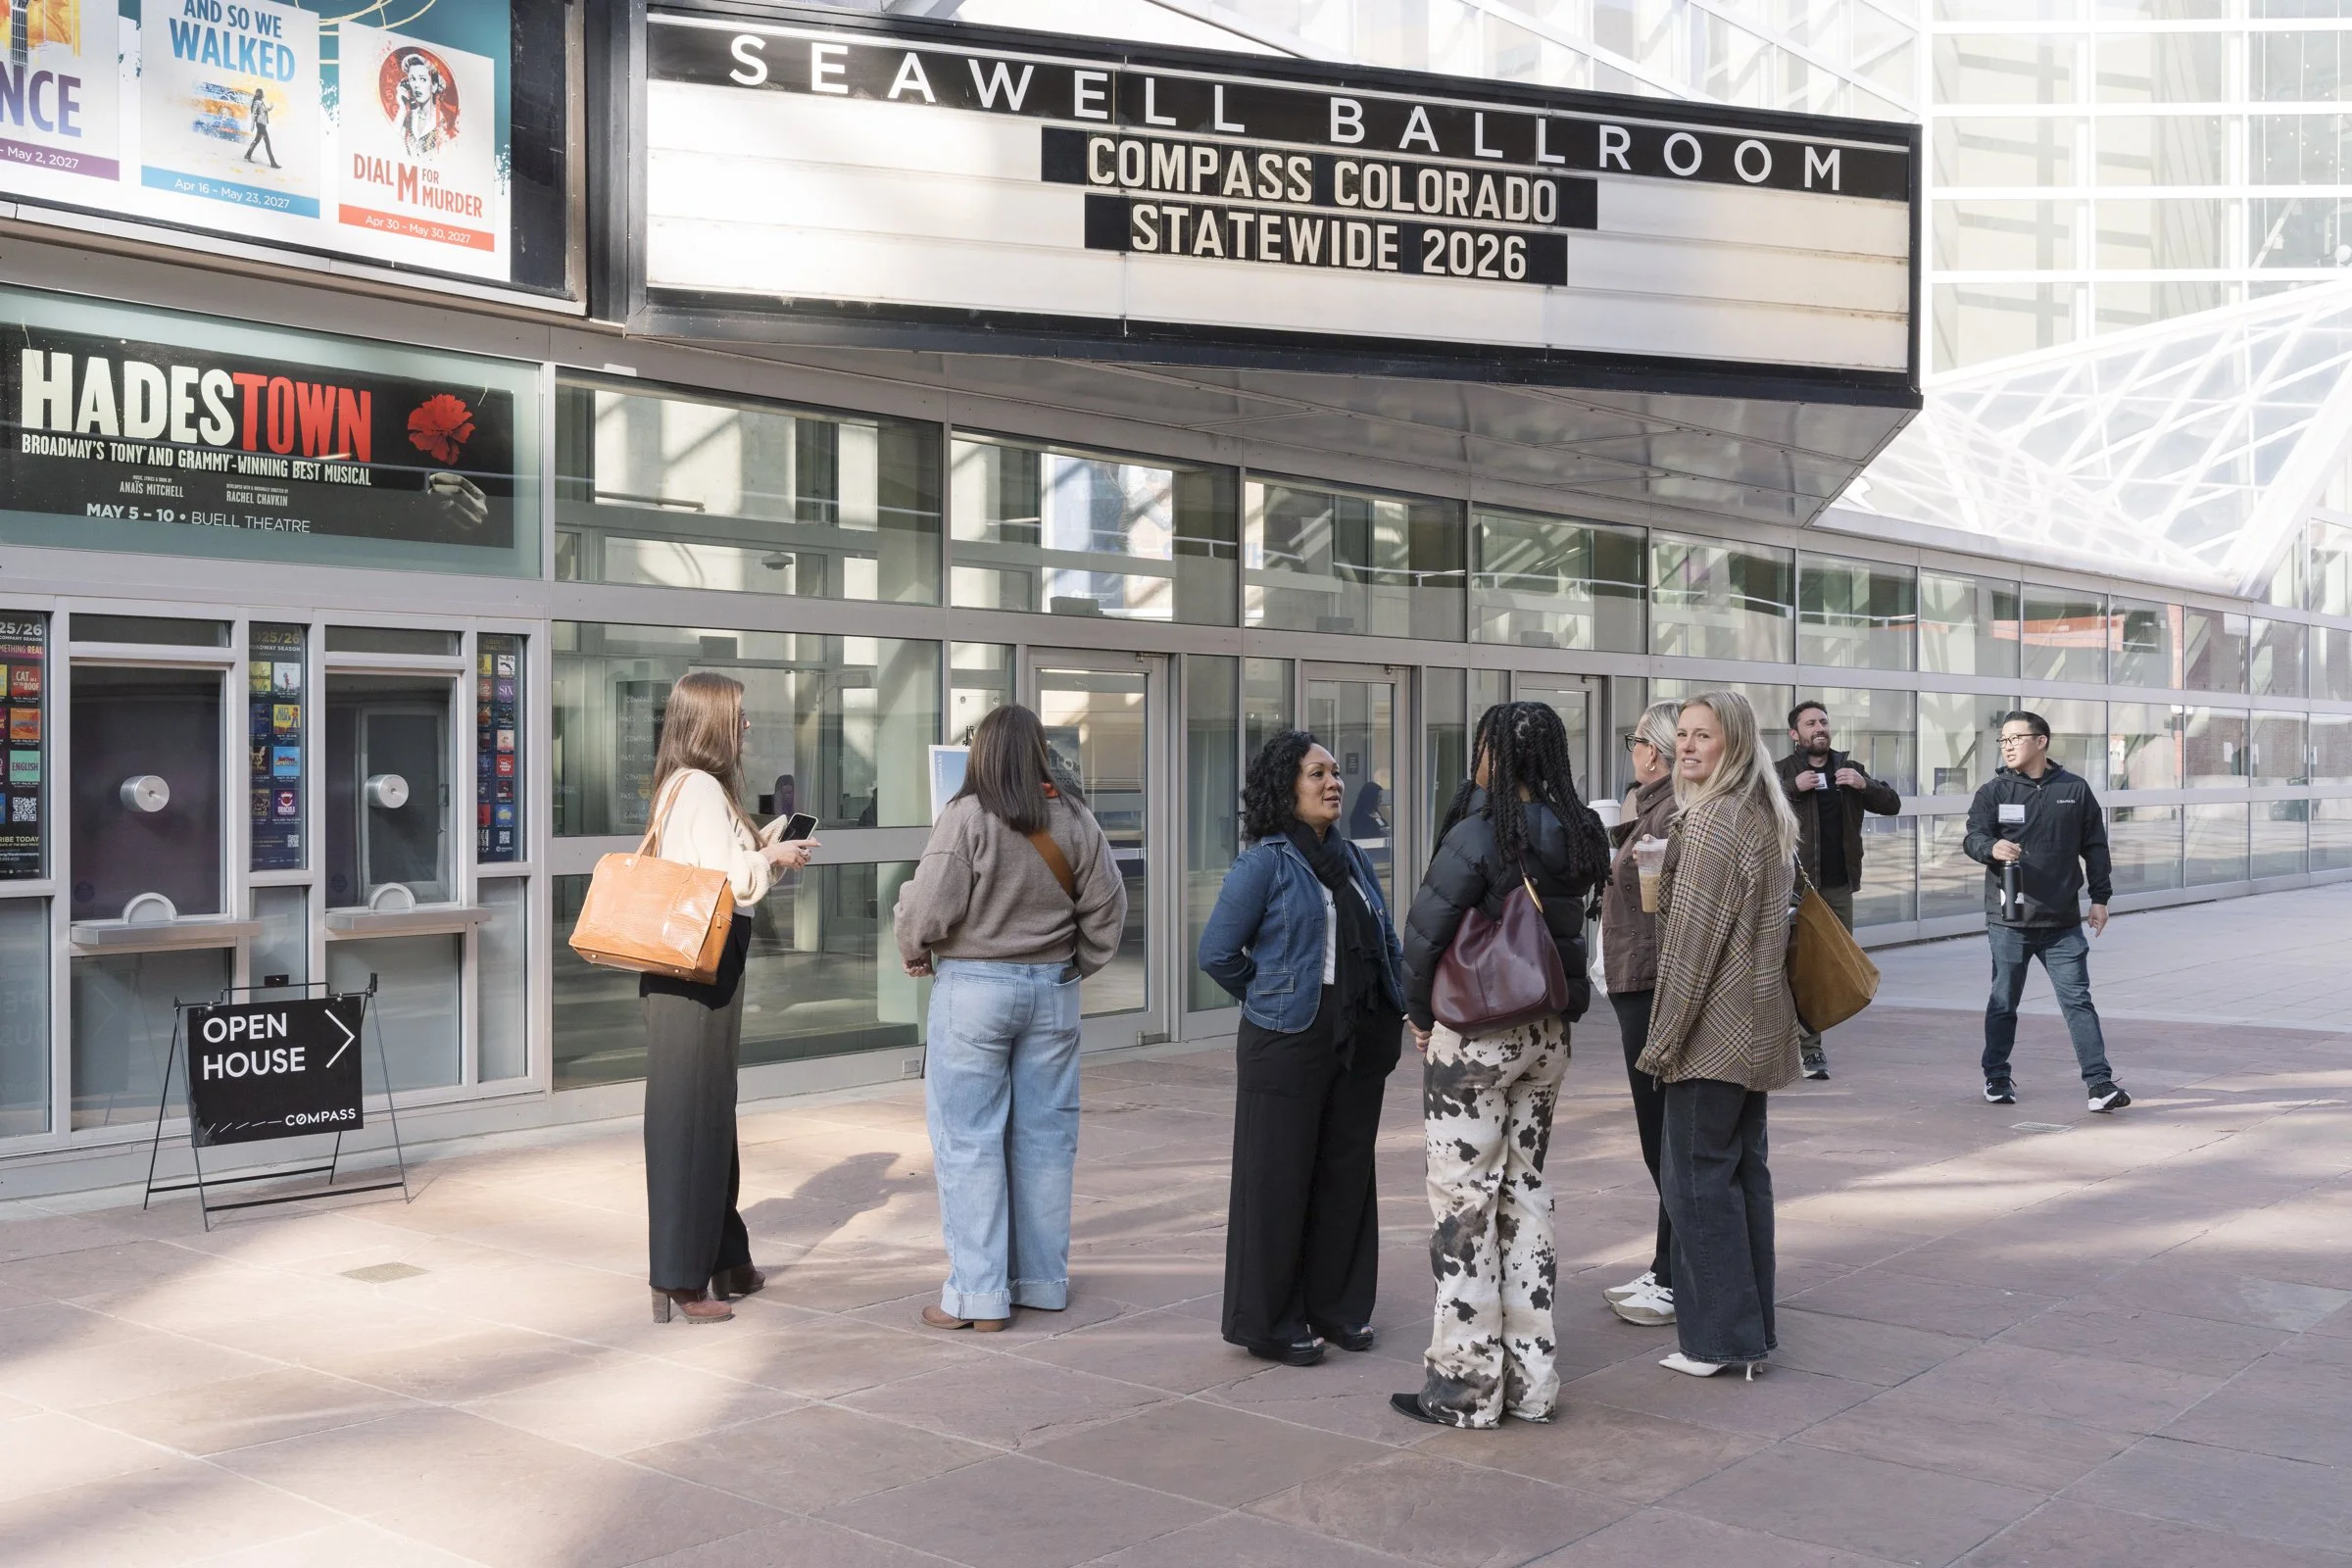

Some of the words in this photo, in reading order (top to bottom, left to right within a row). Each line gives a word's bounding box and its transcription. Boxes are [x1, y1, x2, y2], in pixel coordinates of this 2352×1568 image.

[183, 0, 222, 24] AND
[227, 5, 250, 30] SO
[255, 11, 282, 39] WE
[169, 18, 295, 82] WALKED
[729, 34, 1246, 133] SEAWELL
[1329, 96, 1841, 192] BALLROOM
[8, 146, 32, 162] May
[35, 152, 46, 165] 2,
[49, 154, 79, 169] 2027
[174, 177, 194, 192] Apr
[199, 182, 210, 194] 16
[221, 187, 242, 202] May
[245, 191, 262, 205] 23,
[264, 195, 290, 209] 2027
[354, 153, 394, 186] DIAL
[398, 162, 418, 205] M
[422, 168, 439, 184] FOR
[1088, 136, 1313, 204] COMPASS
[1333, 160, 1557, 225] COLORADO
[422, 185, 482, 219] MURDER
[366, 215, 384, 227] Apr
[386, 219, 400, 230] 30
[410, 223, 428, 237] May
[431, 227, 446, 240] 30,
[448, 231, 470, 243] 2027
[1131, 204, 1398, 271] STATEWIDE
[1422, 227, 1528, 281] 2026
[21, 348, 371, 464] HADESTOWN
[22, 433, 105, 461] BROADWAY'S
[147, 446, 173, 466] AND
[293, 461, 320, 481] BEST
[324, 464, 371, 486] MUSICAL
[120, 480, 143, 494] ANAÏS
[147, 483, 184, 498] MITCHELL
[226, 490, 254, 504] RACHEL
[257, 493, 288, 507] CHAVKIN
[86, 502, 125, 519] MAY
[128, 506, 139, 520] 5
[156, 508, 174, 523] 10
[191, 511, 240, 528] BUELL
[245, 515, 311, 533] THEATRE
[27, 645, 42, 655] REAL
[16, 670, 29, 682] CAT
[24, 682, 39, 691] ROOF
[12, 761, 38, 771] ENGLISH
[203, 1012, 287, 1044] OPEN
[203, 1047, 306, 1081] HOUSE
[285, 1108, 356, 1127] COMPASS
